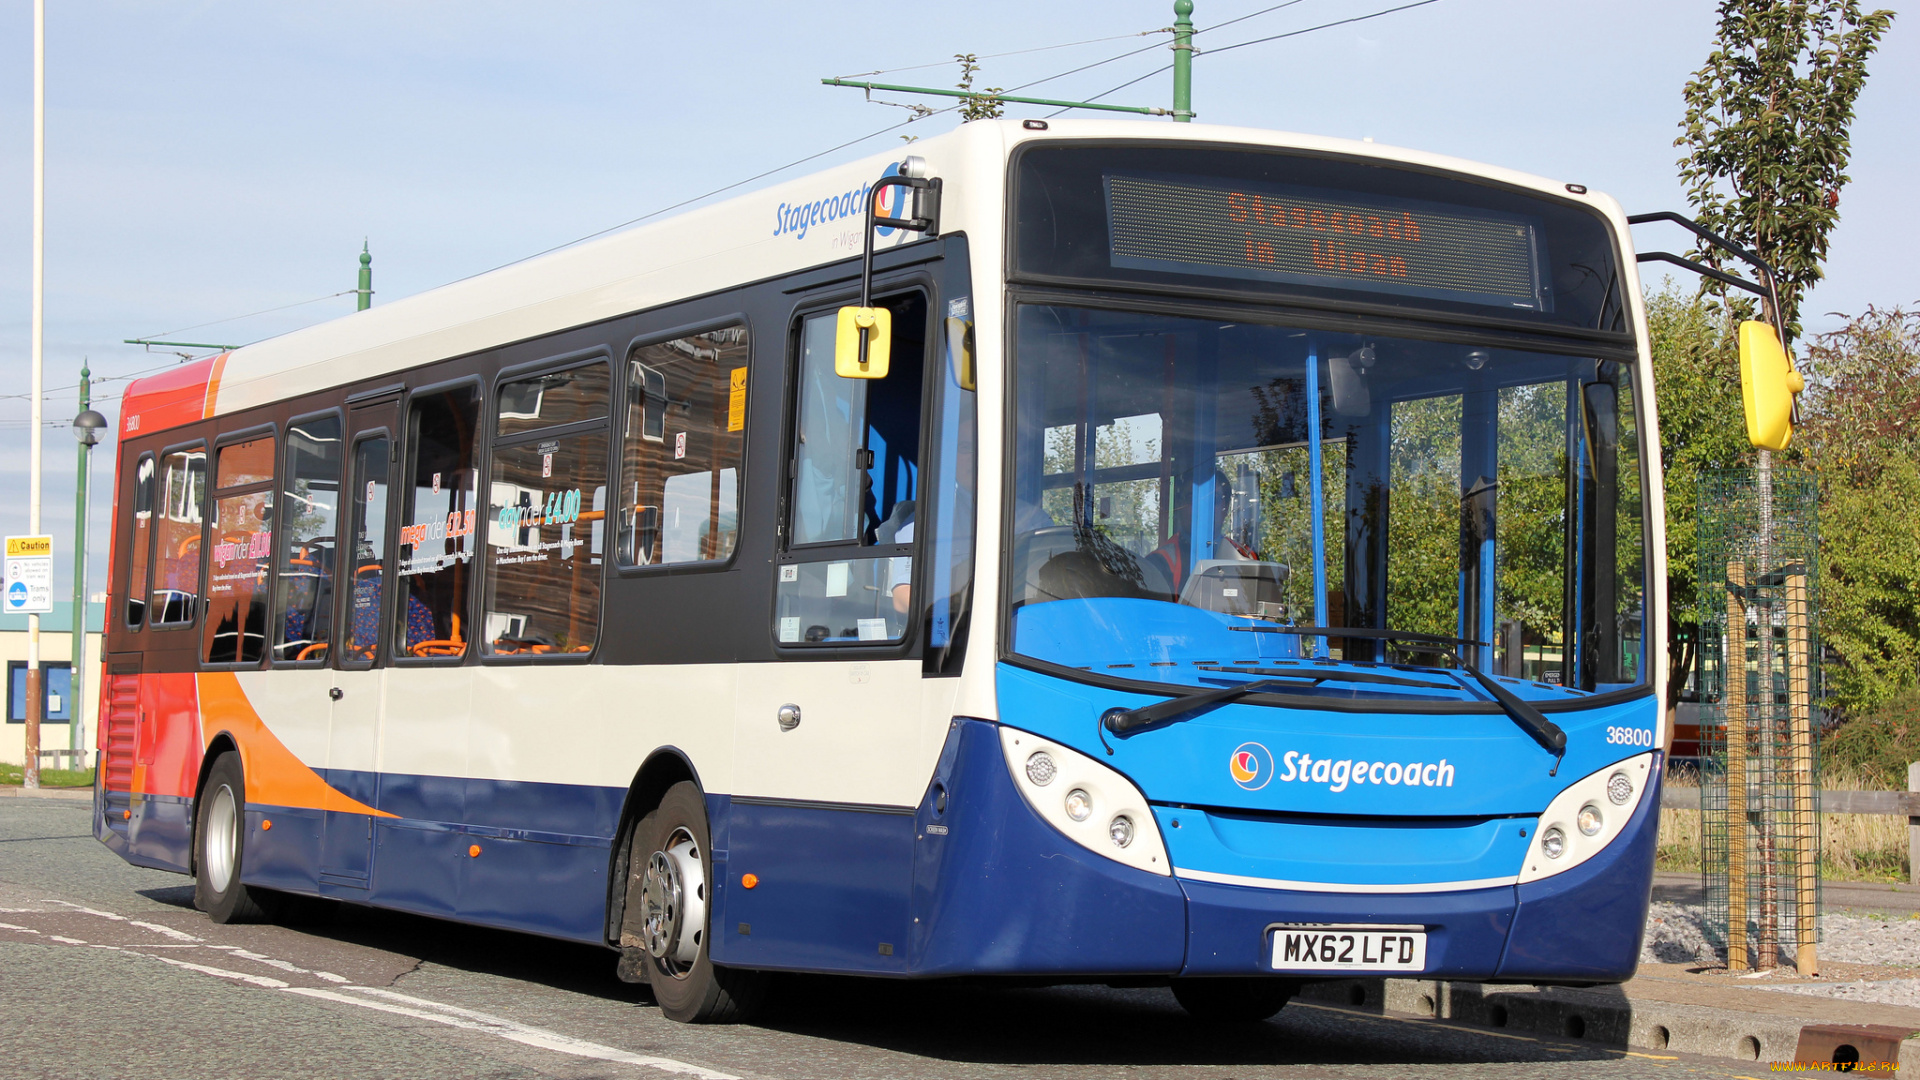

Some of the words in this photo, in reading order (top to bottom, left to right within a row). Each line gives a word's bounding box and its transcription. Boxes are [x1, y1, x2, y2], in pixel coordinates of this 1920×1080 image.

[773, 181, 870, 240] Stagecoach
[1228, 192, 1421, 242] Stagecoach
[840, 230, 862, 250] Wigan
[1245, 232, 1275, 263] in
[1312, 239, 1407, 277] Wigan
[544, 488, 581, 526] £4.00
[20, 541, 50, 550] Caution
[400, 513, 446, 551] megarider
[446, 509, 475, 539] £12.50
[32, 594, 46, 603] only
[1606, 726, 1652, 747] 36800
[1280, 750, 1455, 793] Stagecoach
[1284, 934, 1355, 963] MX62
[1362, 935, 1414, 963] LFD
